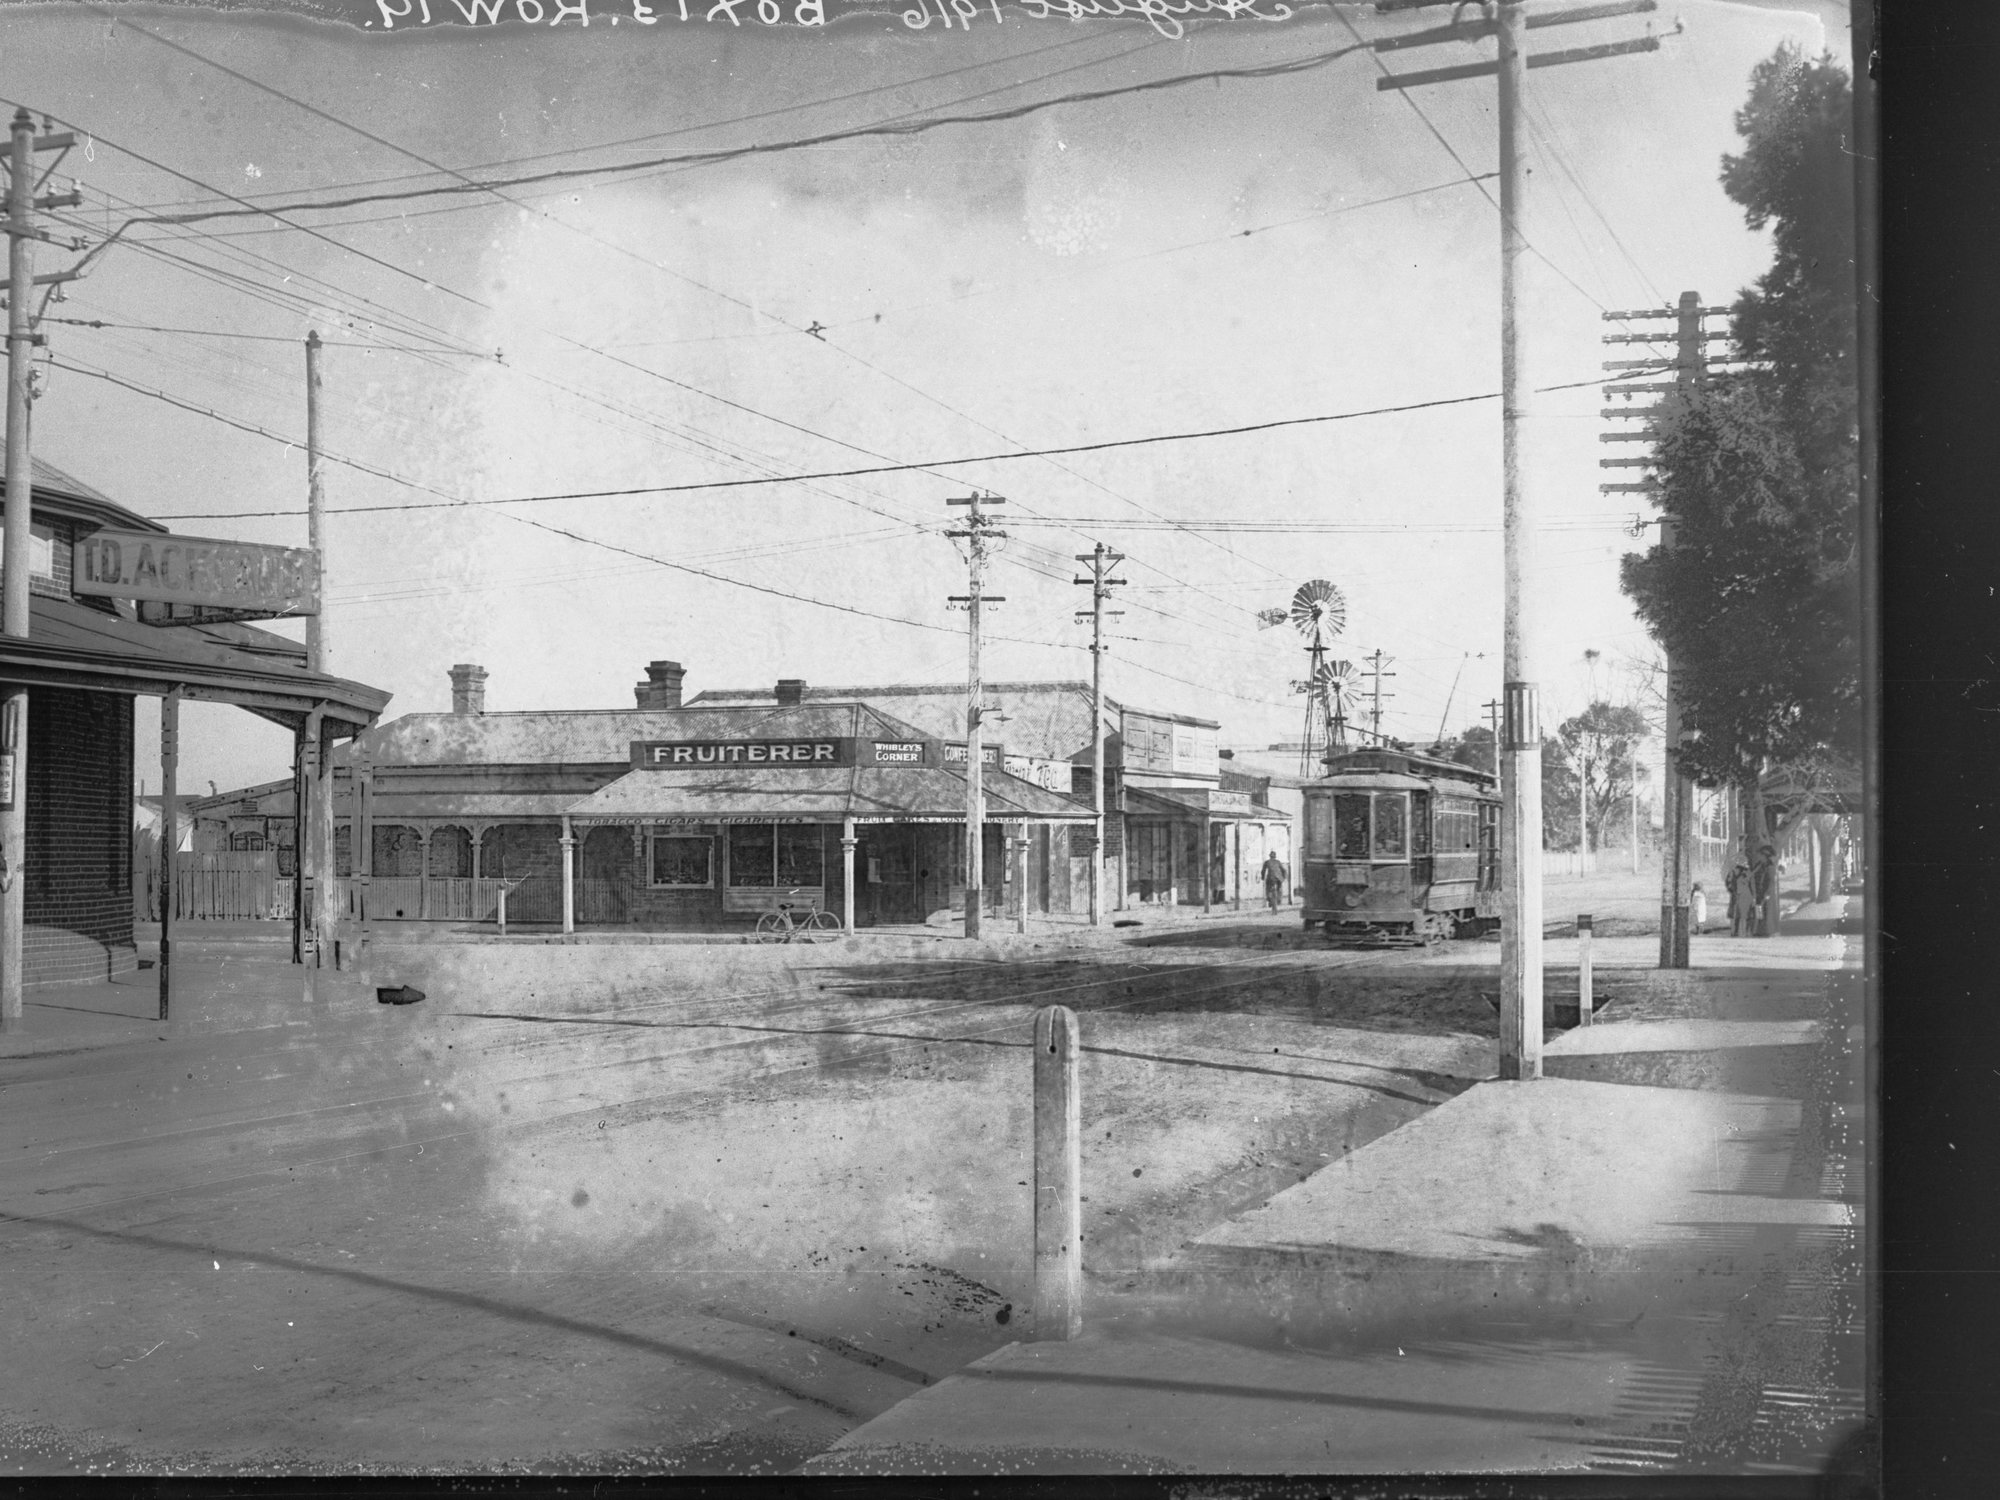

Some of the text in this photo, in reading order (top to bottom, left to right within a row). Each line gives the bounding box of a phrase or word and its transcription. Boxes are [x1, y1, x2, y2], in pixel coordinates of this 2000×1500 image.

[875, 742, 923, 752] WHIBLEY'S
[654, 743, 835, 763] FRUITERER
[875, 750, 919, 762] CORNER
[654, 816, 705, 825] CIGARS
